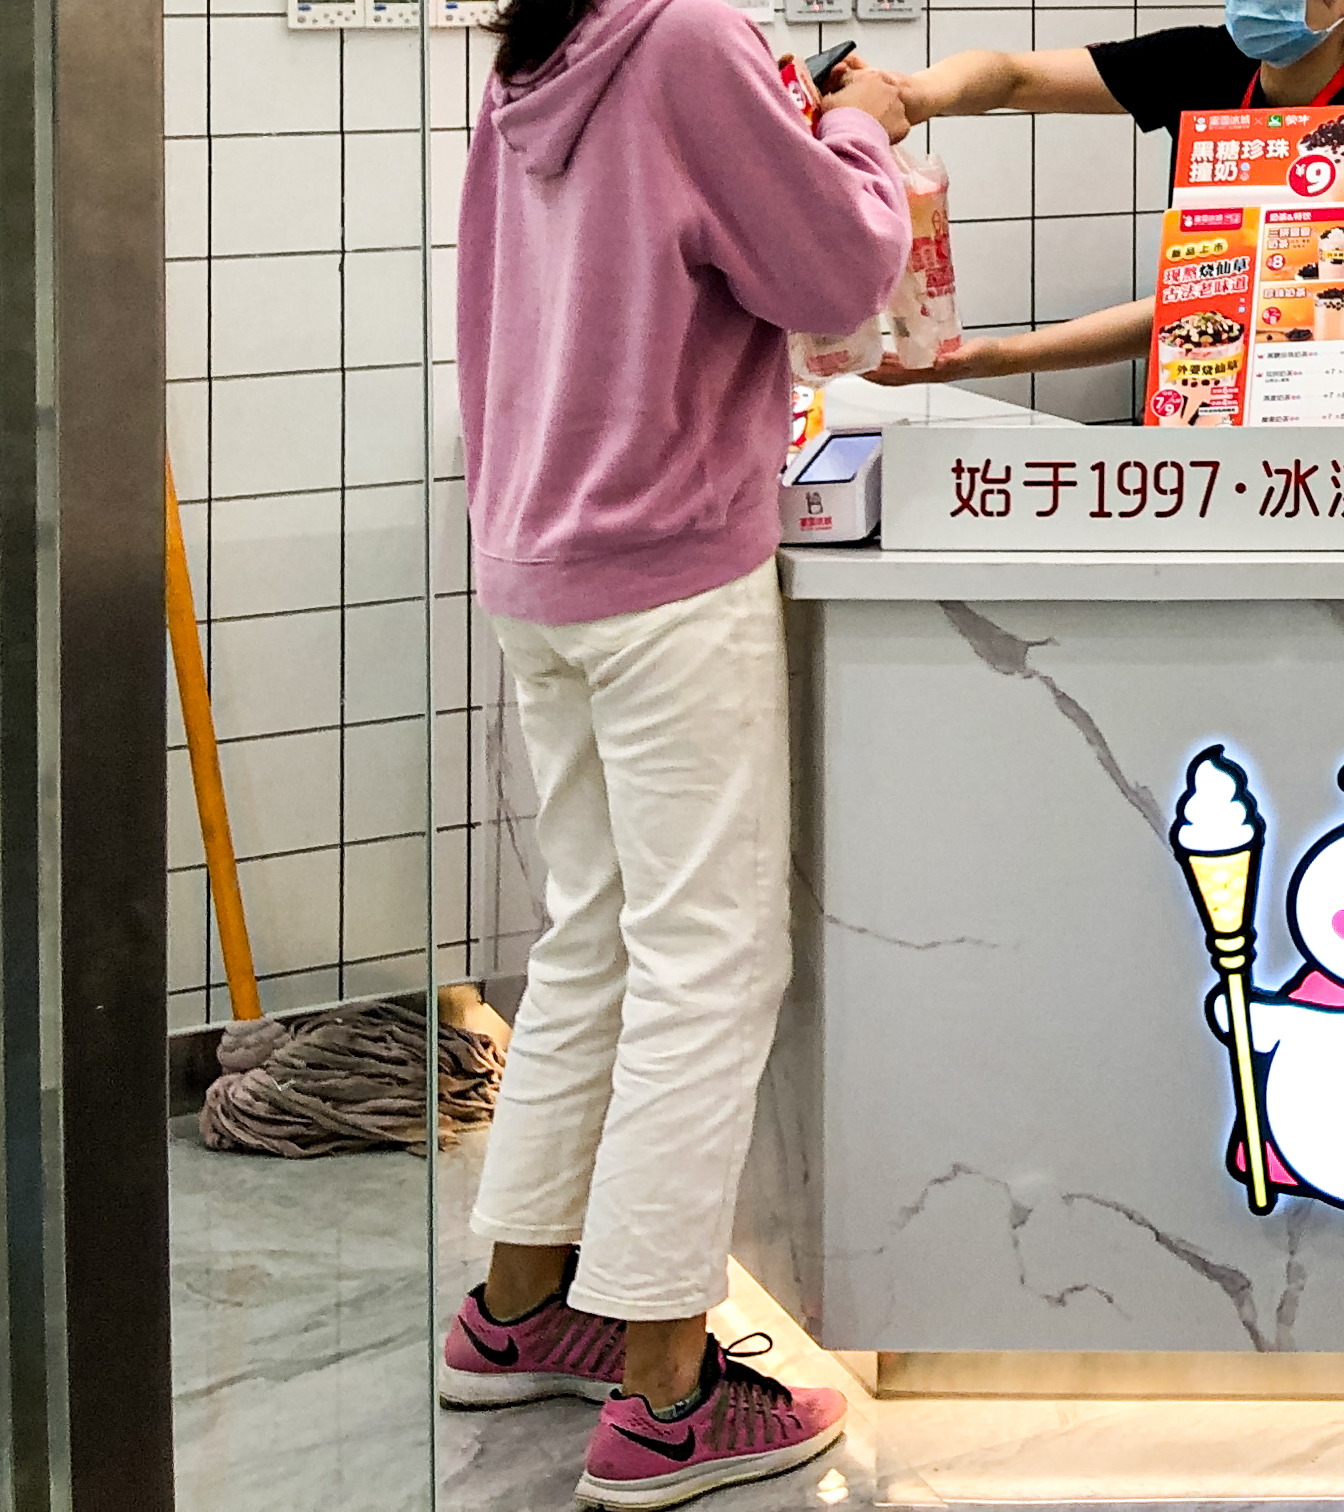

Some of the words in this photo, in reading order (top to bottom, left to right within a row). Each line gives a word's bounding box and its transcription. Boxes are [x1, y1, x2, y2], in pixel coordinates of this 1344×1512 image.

[1190, 138, 1290, 162] 黑糖珍珠
[1188, 160, 1239, 183] 撞奶
[1163, 257, 1249, 285] 现熬烧仙草
[1162, 277, 1248, 303] 古法老味道
